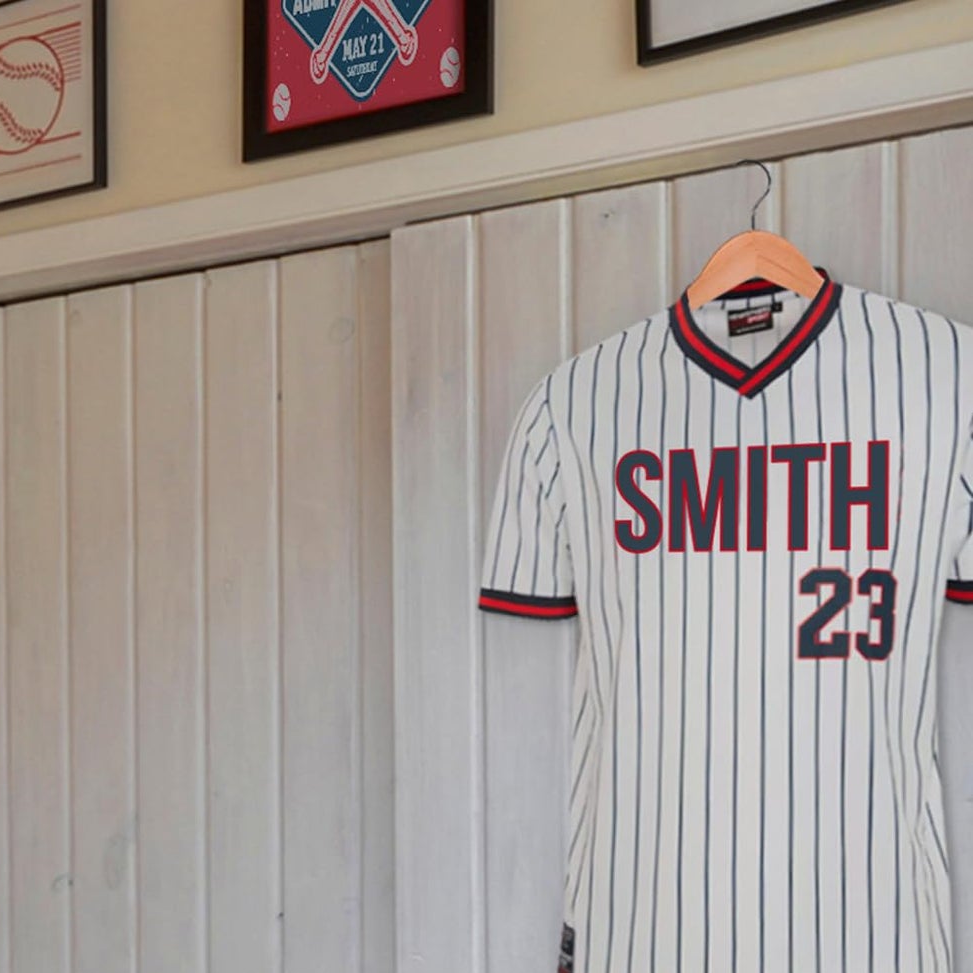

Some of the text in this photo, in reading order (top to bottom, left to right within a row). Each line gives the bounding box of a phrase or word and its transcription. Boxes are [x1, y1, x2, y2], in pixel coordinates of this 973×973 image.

[342, 32, 384, 61] MAY 21
[615, 440, 889, 554] SMITH
[797, 568, 897, 661] 23
